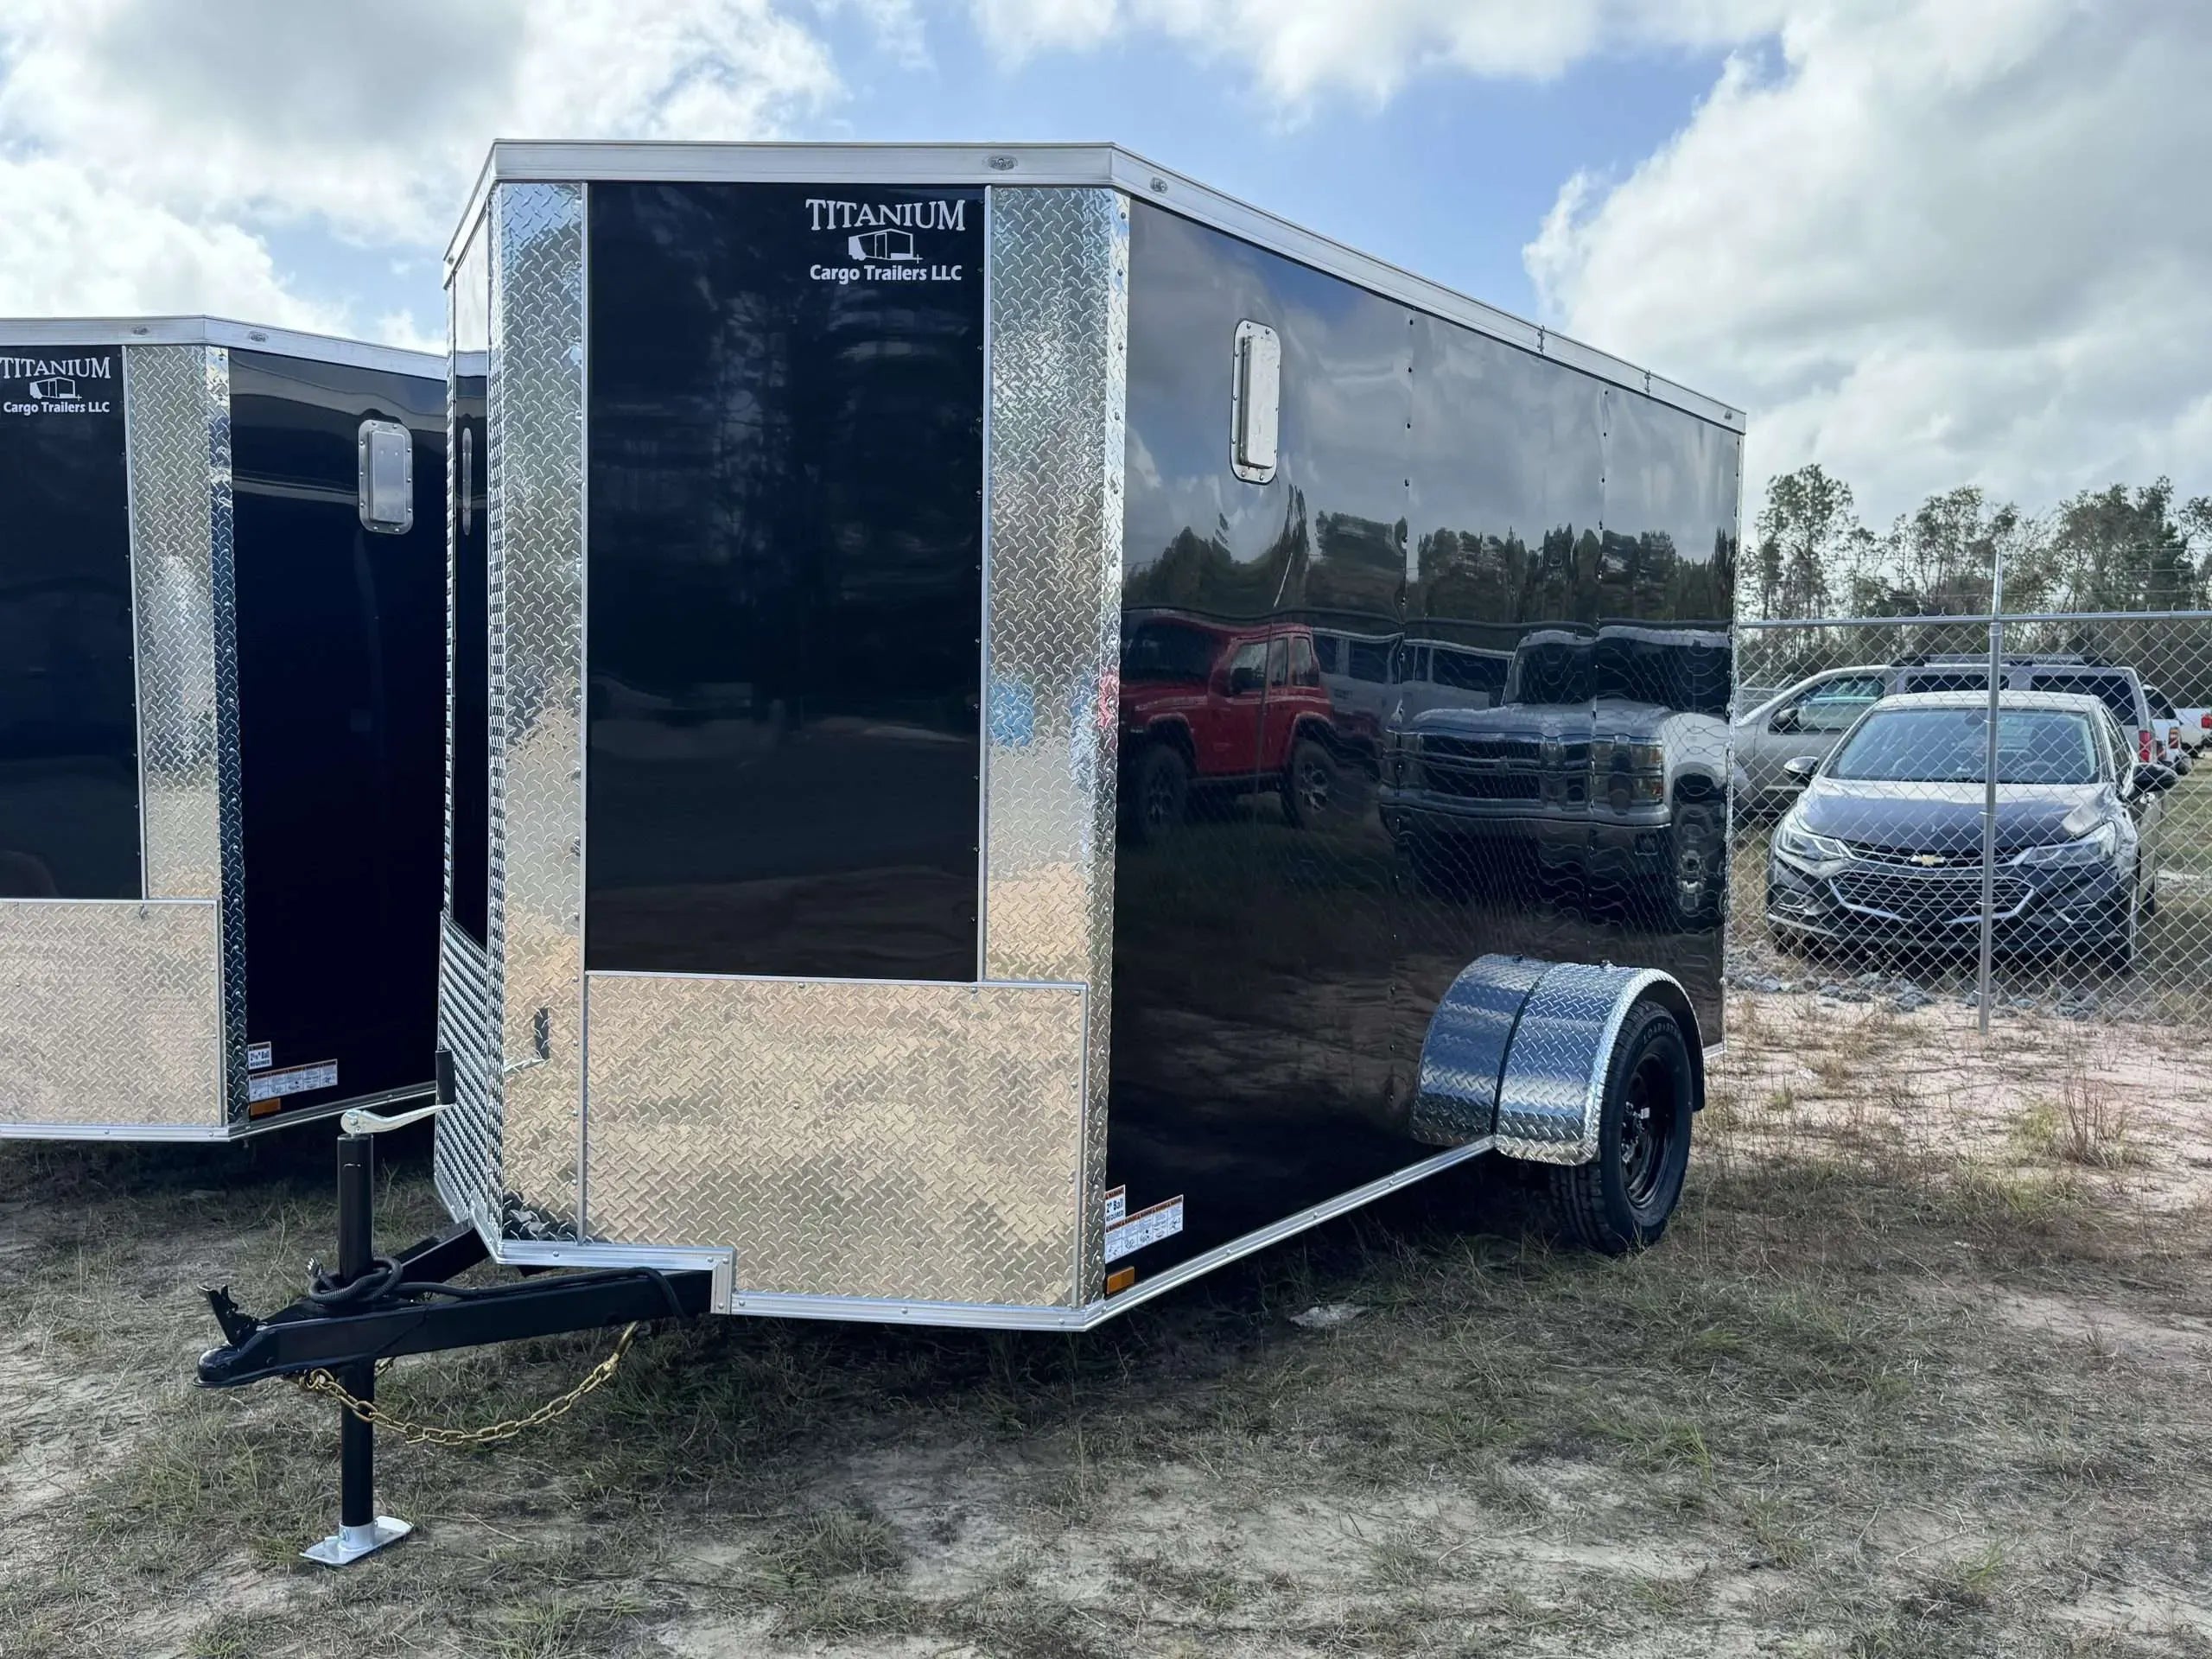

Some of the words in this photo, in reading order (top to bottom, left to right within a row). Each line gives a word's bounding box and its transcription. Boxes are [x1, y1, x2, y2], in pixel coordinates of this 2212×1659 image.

[805, 199, 966, 231] TITANIUM
[810, 264, 860, 285] Cargo
[864, 264, 927, 281] Trailers
[931, 265, 963, 281] LLC
[0, 357, 111, 378] TITANIUM
[3, 402, 39, 416] Cargo
[41, 402, 86, 413] Trailers
[88, 402, 111, 413] LLC
